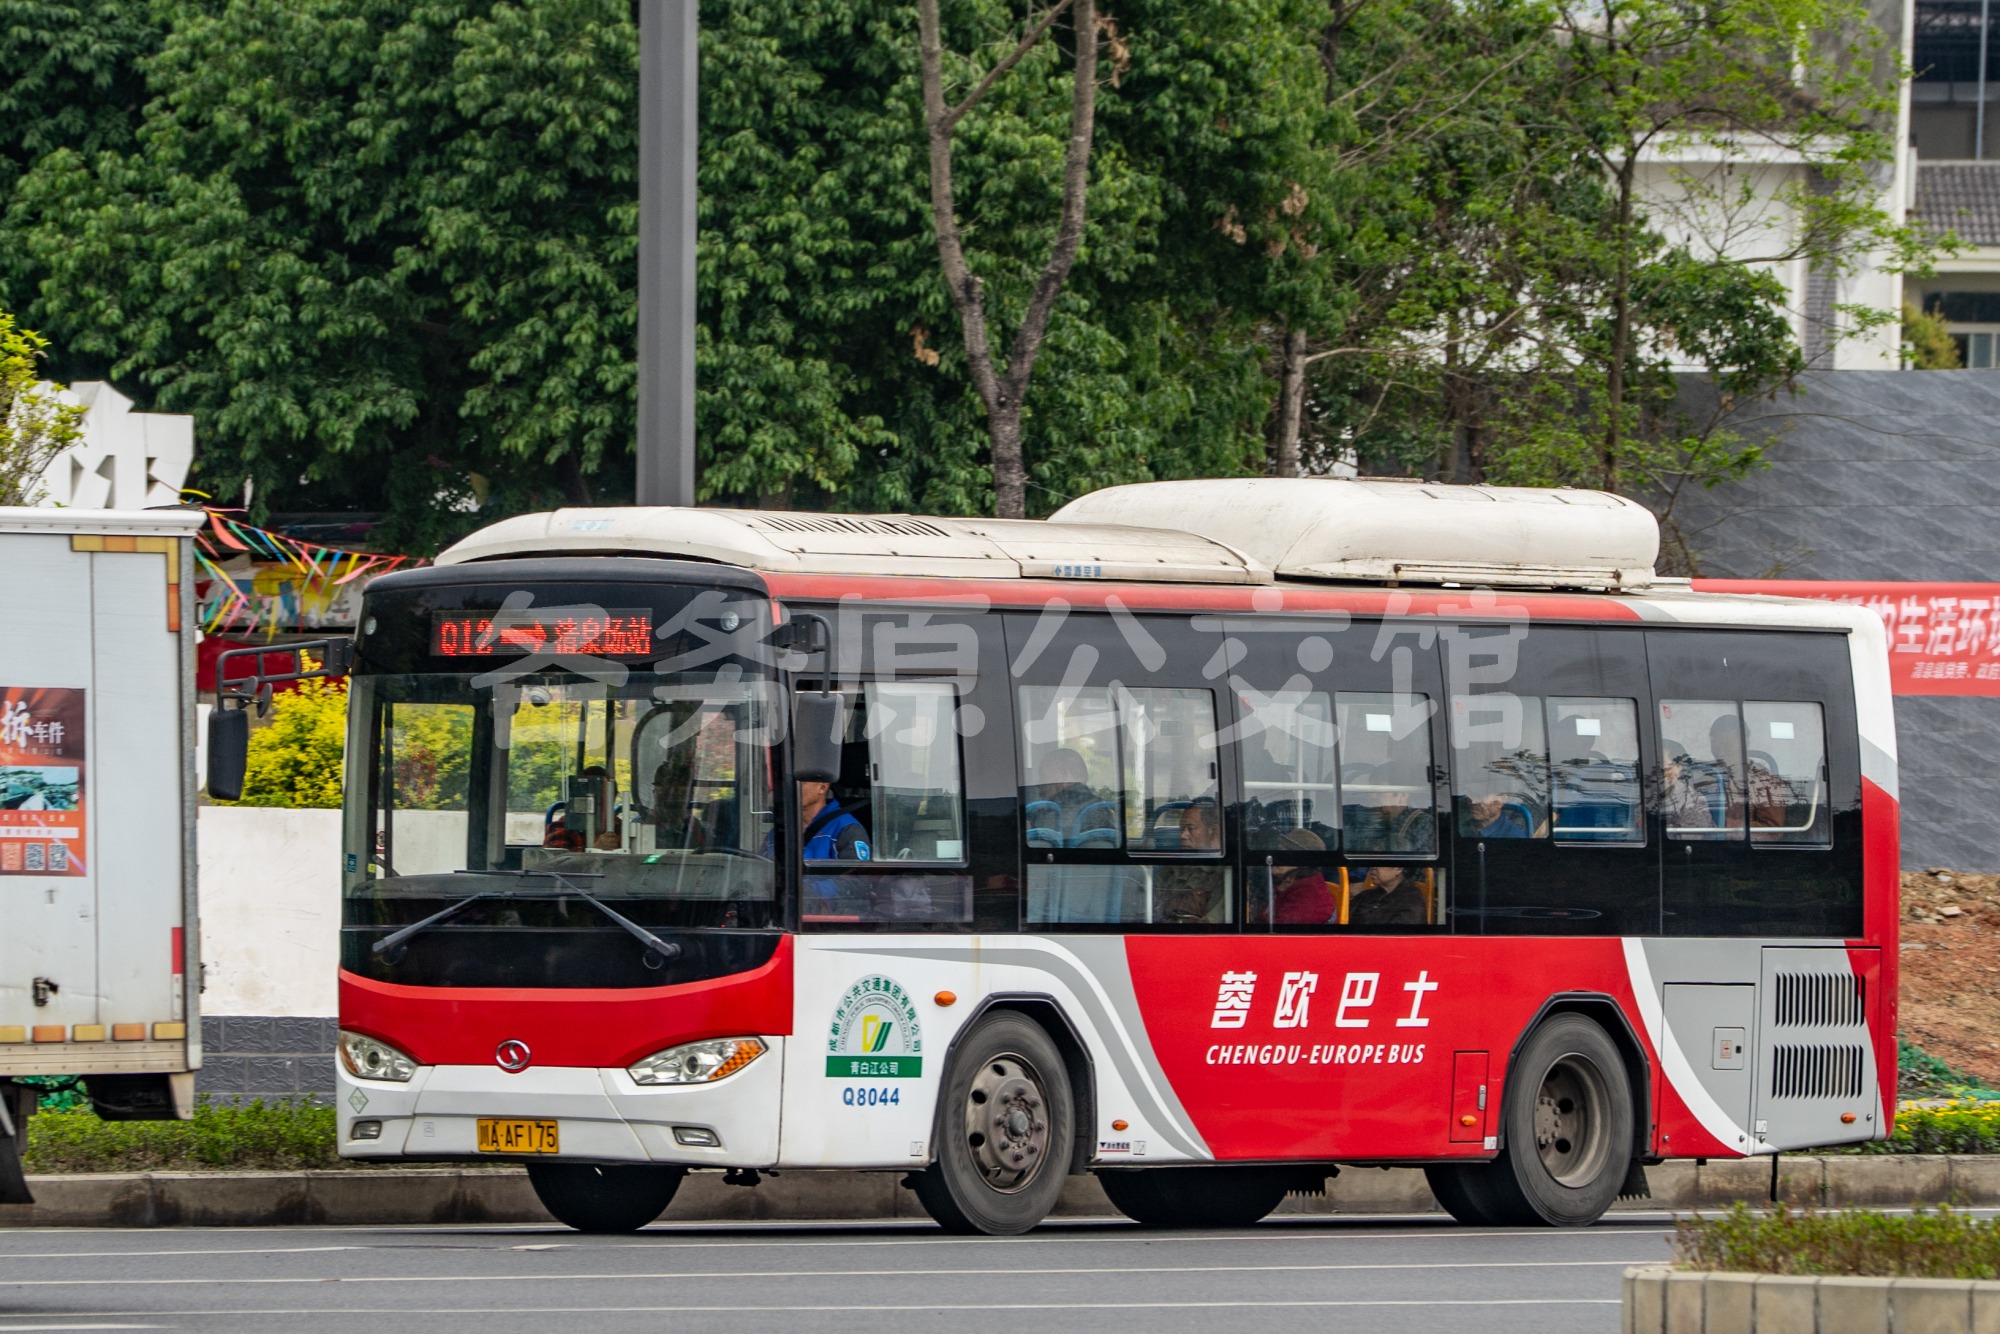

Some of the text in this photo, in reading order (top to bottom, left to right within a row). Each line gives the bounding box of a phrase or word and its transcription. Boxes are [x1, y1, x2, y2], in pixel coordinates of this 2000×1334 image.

[441, 617, 652, 655] Q12 清泉场站
[1210, 970, 1439, 1029] 蓉欧巴士
[828, 977, 921, 1053] 成都市公共交通集团有限公司
[850, 1061, 899, 1075] 青白江公司
[1205, 1044, 1426, 1065] CHENGDU-EUROPE BUS
[843, 1087, 900, 1106] Q8044
